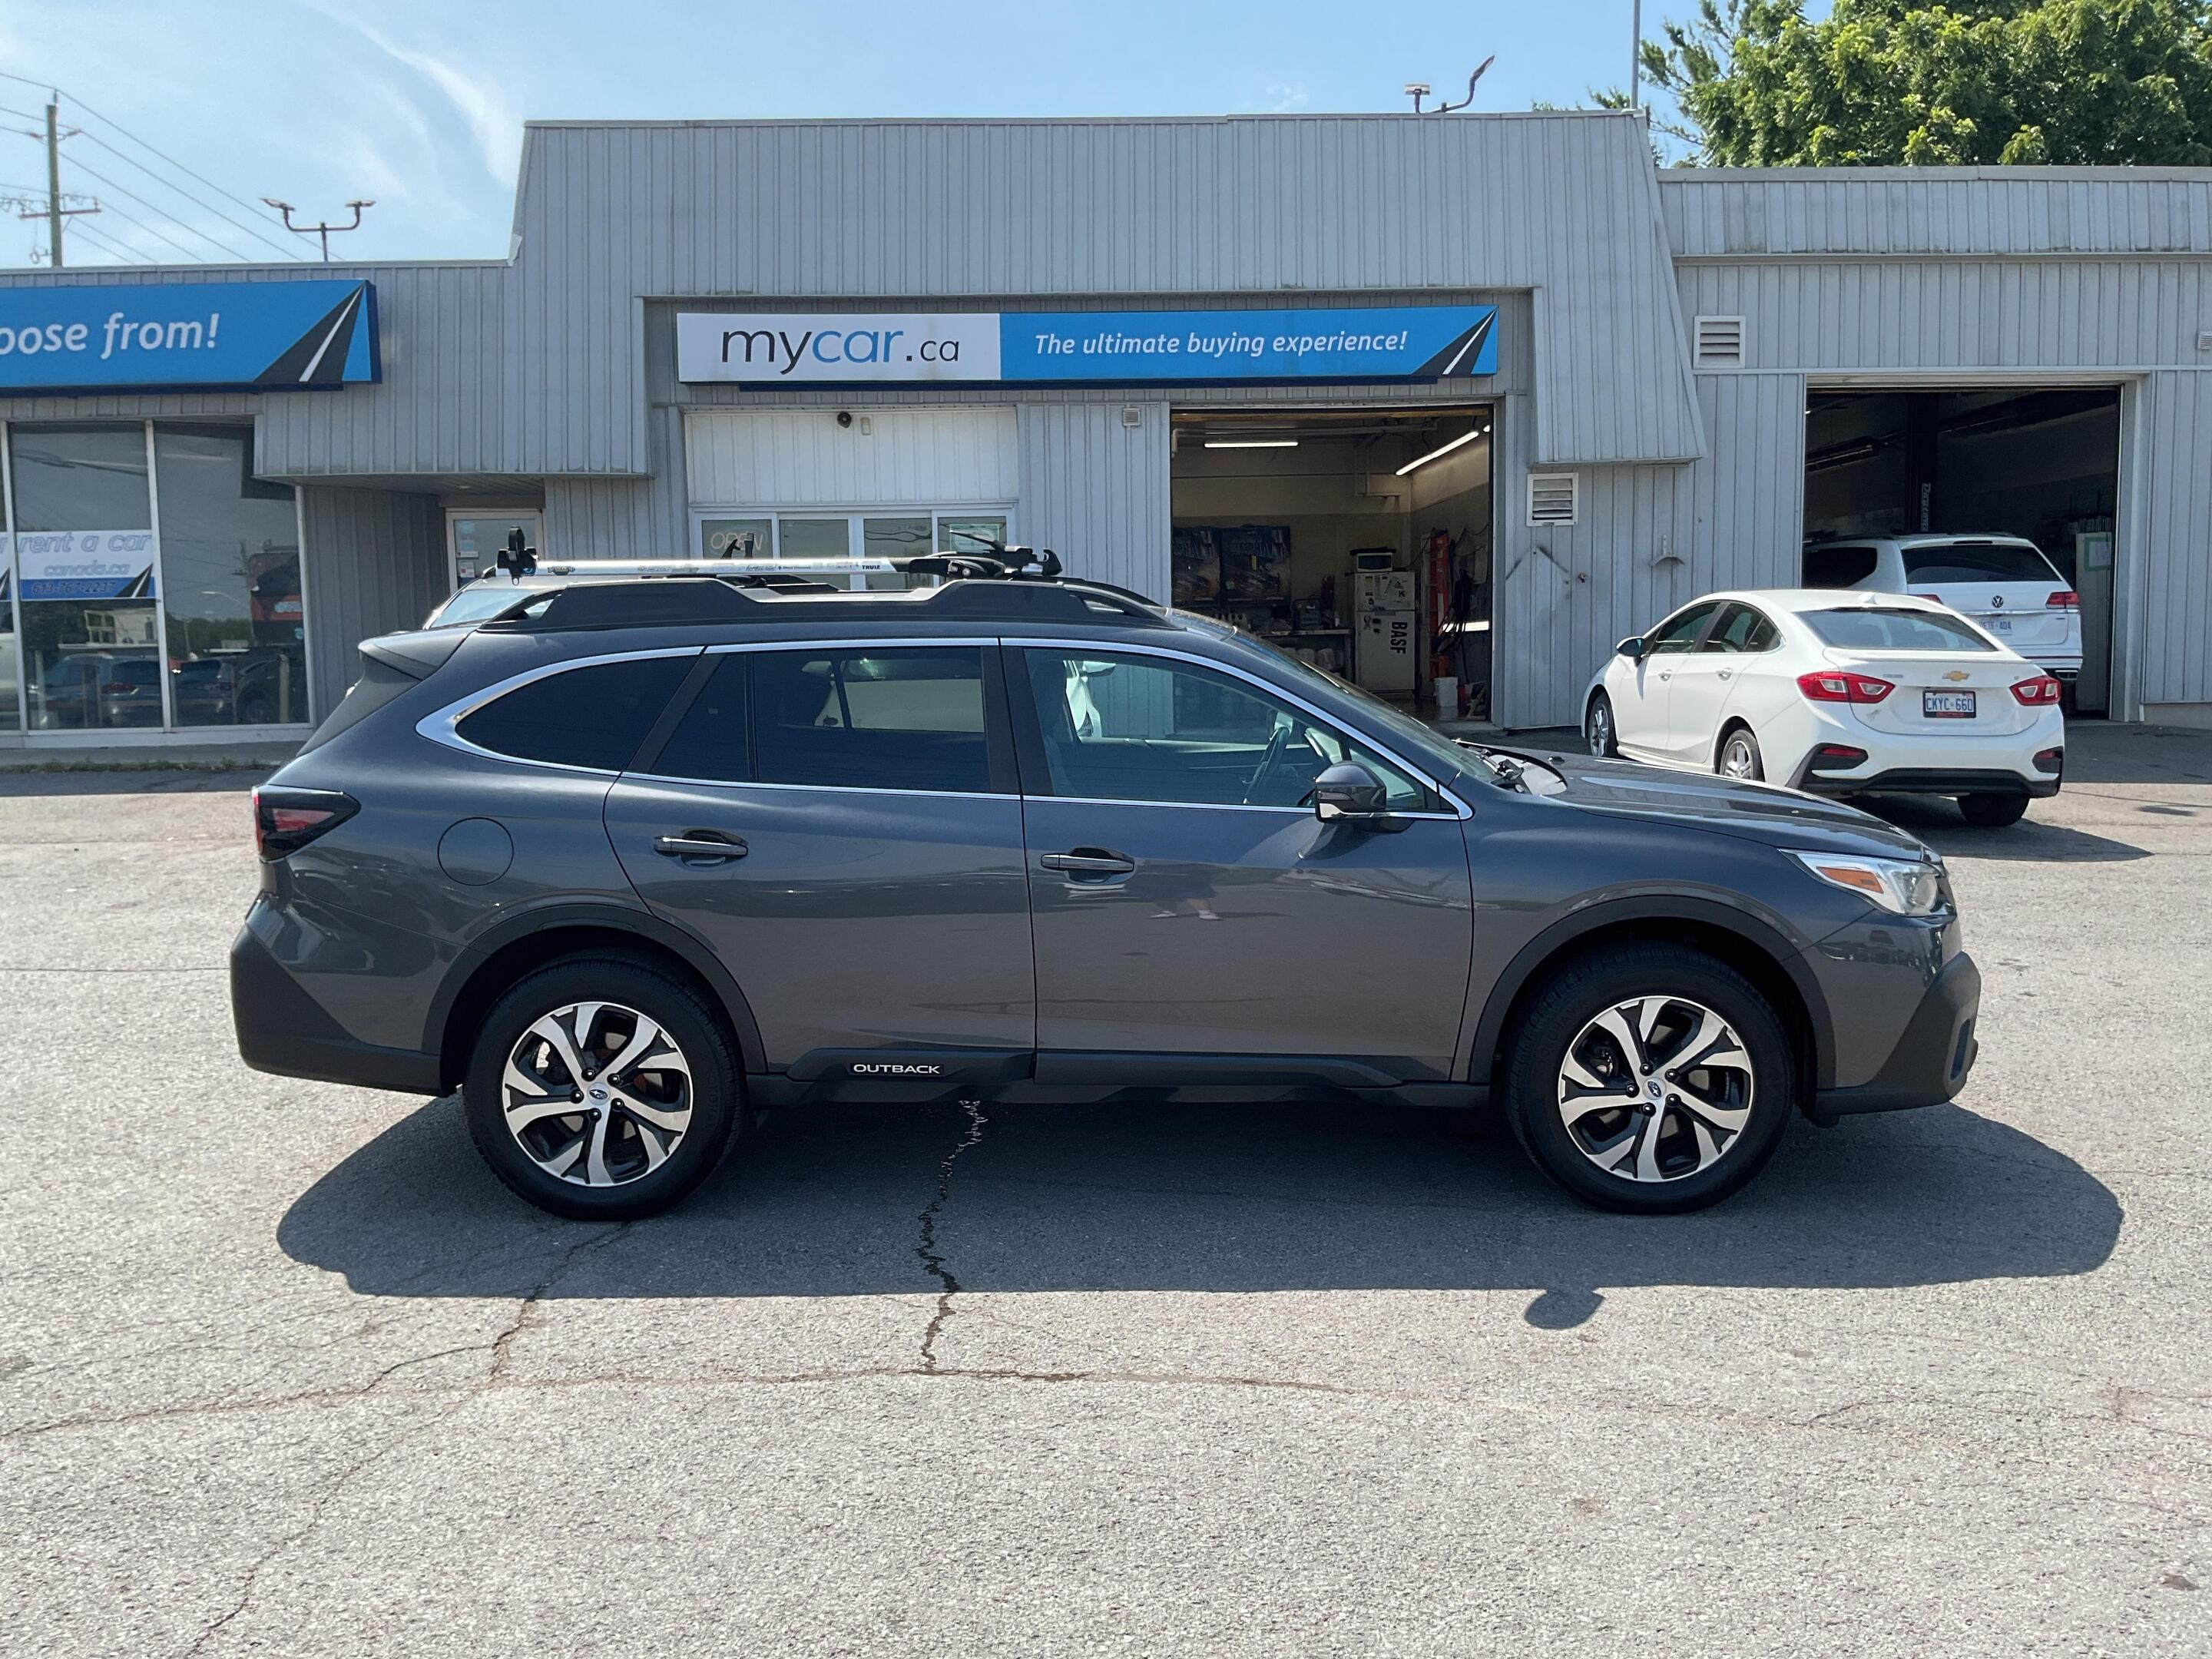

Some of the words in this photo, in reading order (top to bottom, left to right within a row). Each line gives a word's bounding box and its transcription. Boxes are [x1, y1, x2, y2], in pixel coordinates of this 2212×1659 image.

[100, 312, 220, 360] from!
[1035, 333, 1075, 354] The
[1082, 333, 1180, 354] ultimate
[1187, 332, 1265, 358] buying
[1272, 330, 1408, 357] experience!
[720, 329, 959, 375] mycar.ca
[19, 531, 74, 553] rent
[81, 535, 99, 551] a
[108, 534, 152, 551] car
[1389, 621, 1409, 654] BASF
[853, 1064, 941, 1075] OUTBACK
